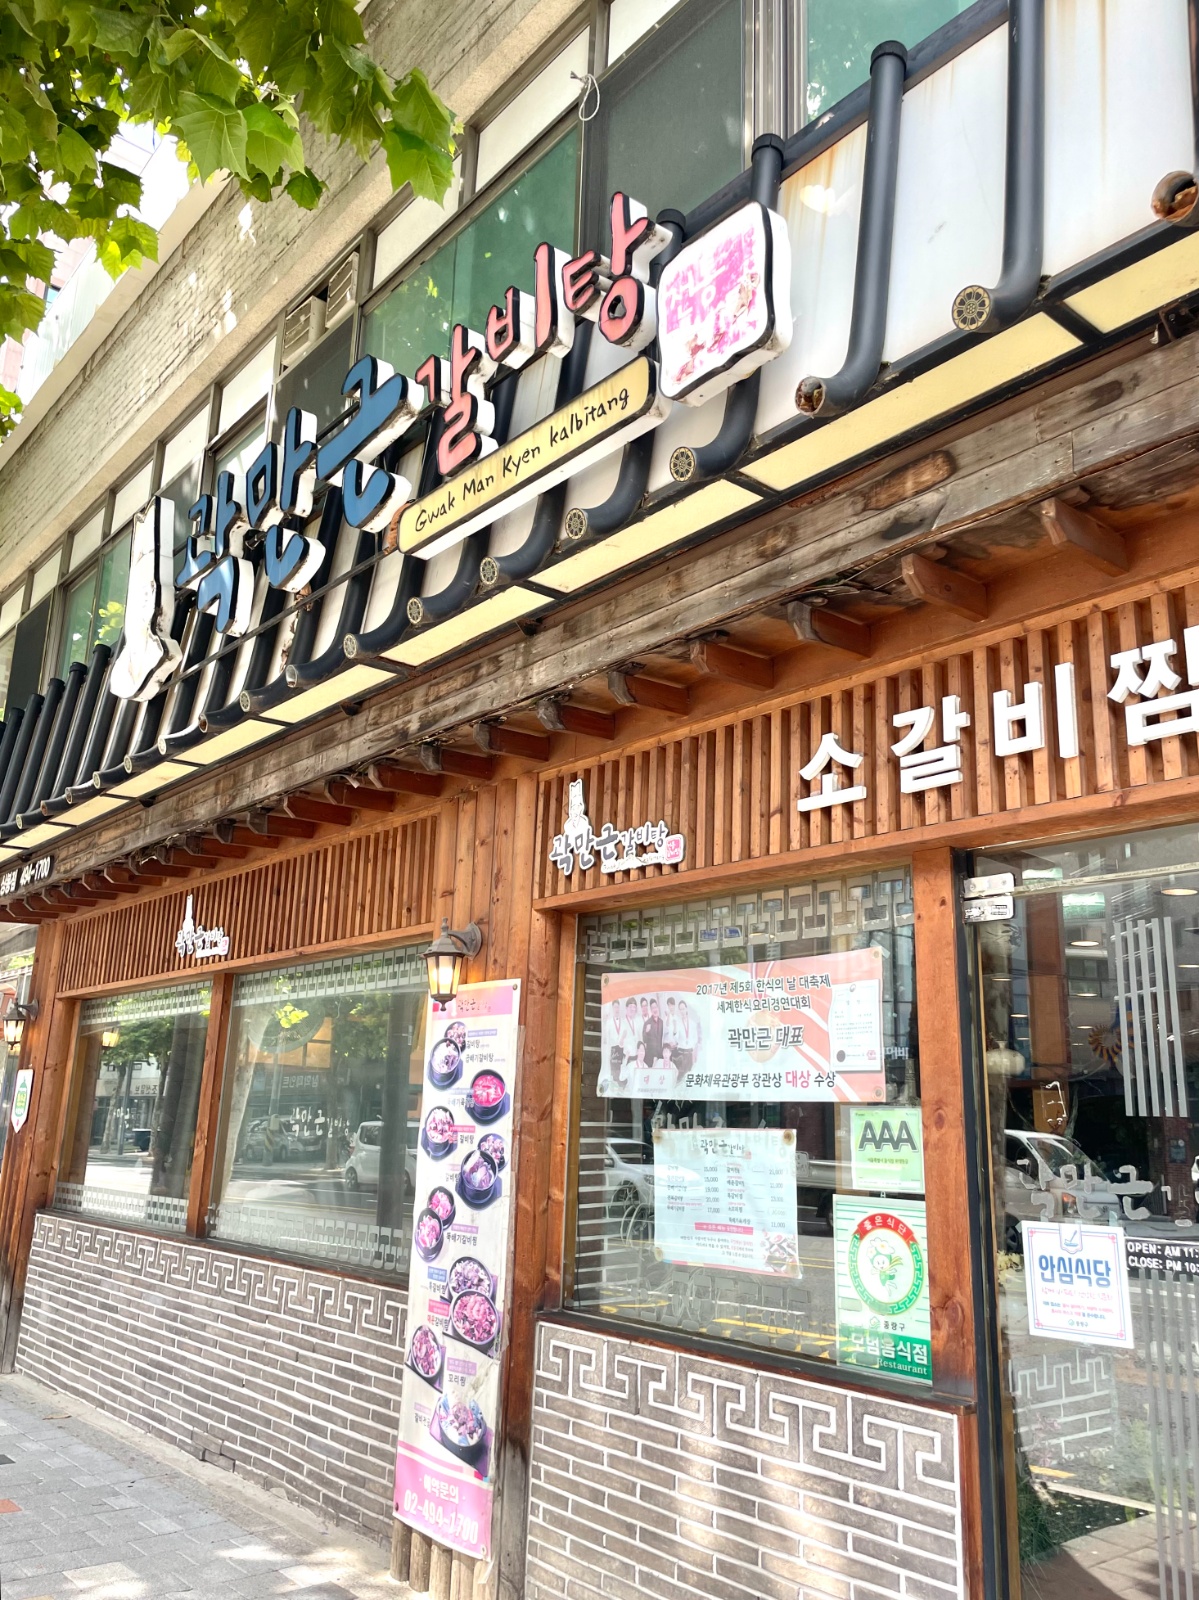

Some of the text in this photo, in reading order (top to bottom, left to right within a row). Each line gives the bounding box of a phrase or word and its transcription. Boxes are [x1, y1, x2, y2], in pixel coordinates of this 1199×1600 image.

[176, 354, 410, 635] 곽만근
[415, 191, 655, 476] 갈비탕
[415, 388, 629, 533] Gwak Man Kyen kalbitang
[550, 825, 618, 873] 곽만근
[621, 822, 665, 858] 갈비탕
[696, 974, 831, 995] 2017년 제5회 한식의 날 대축제
[717, 995, 811, 1014] 세계한식요리경연대회
[728, 1026, 804, 1050] 곽만근 대표
[685, 1070, 836, 1089] 문화체육관광부 장관상 대상 수상
[858, 1120, 918, 1151] AAA
[1127, 1241, 1162, 1255] OPEN:
[1164, 1245, 1181, 1257] AM
[1038, 1254, 1112, 1289] 안심식당
[1128, 1256, 1163, 1269] CLOSE:
[1166, 1260, 1182, 1272] PM
[883, 1320, 906, 1332] 중랑구
[851, 1331, 928, 1365] 모범음식점
[877, 1357, 928, 1376] Restaurant
[424, 1474, 459, 1505] 예약문의
[403, 1488, 479, 1545] 02-494-1700
